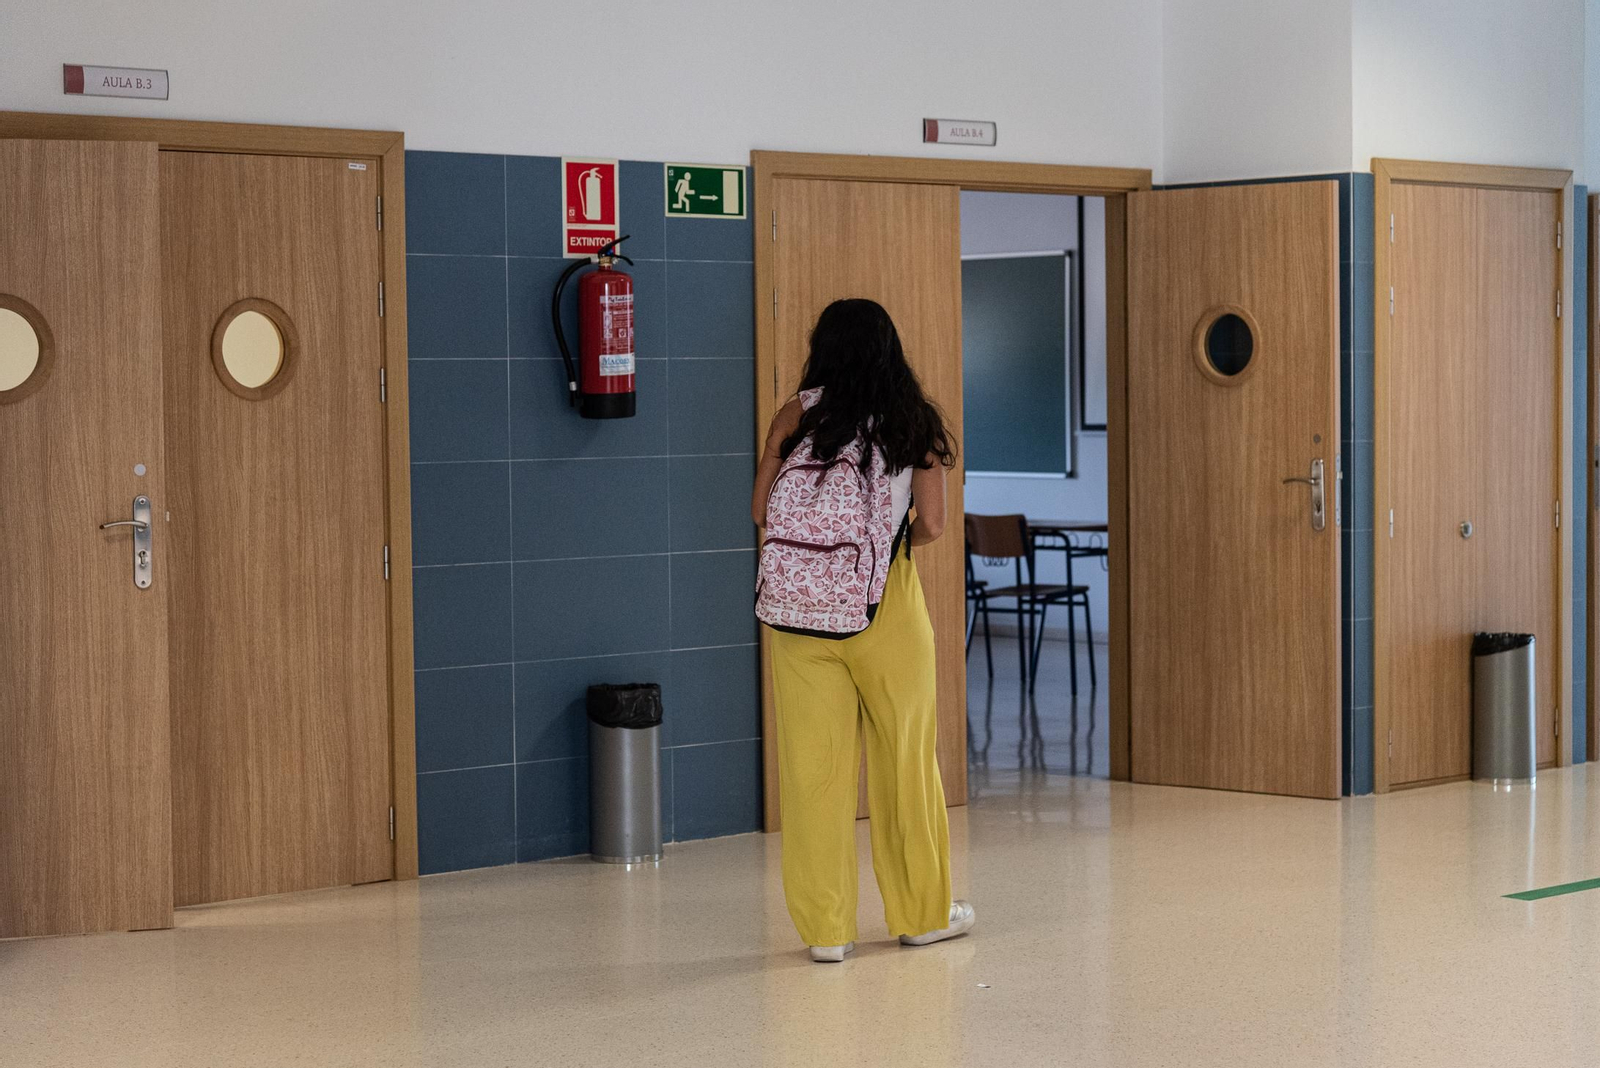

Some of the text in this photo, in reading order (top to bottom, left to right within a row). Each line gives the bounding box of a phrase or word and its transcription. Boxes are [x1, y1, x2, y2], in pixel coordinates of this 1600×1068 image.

[102, 76, 152, 90] AULA B.3
[950, 127, 984, 138] AULA B.4
